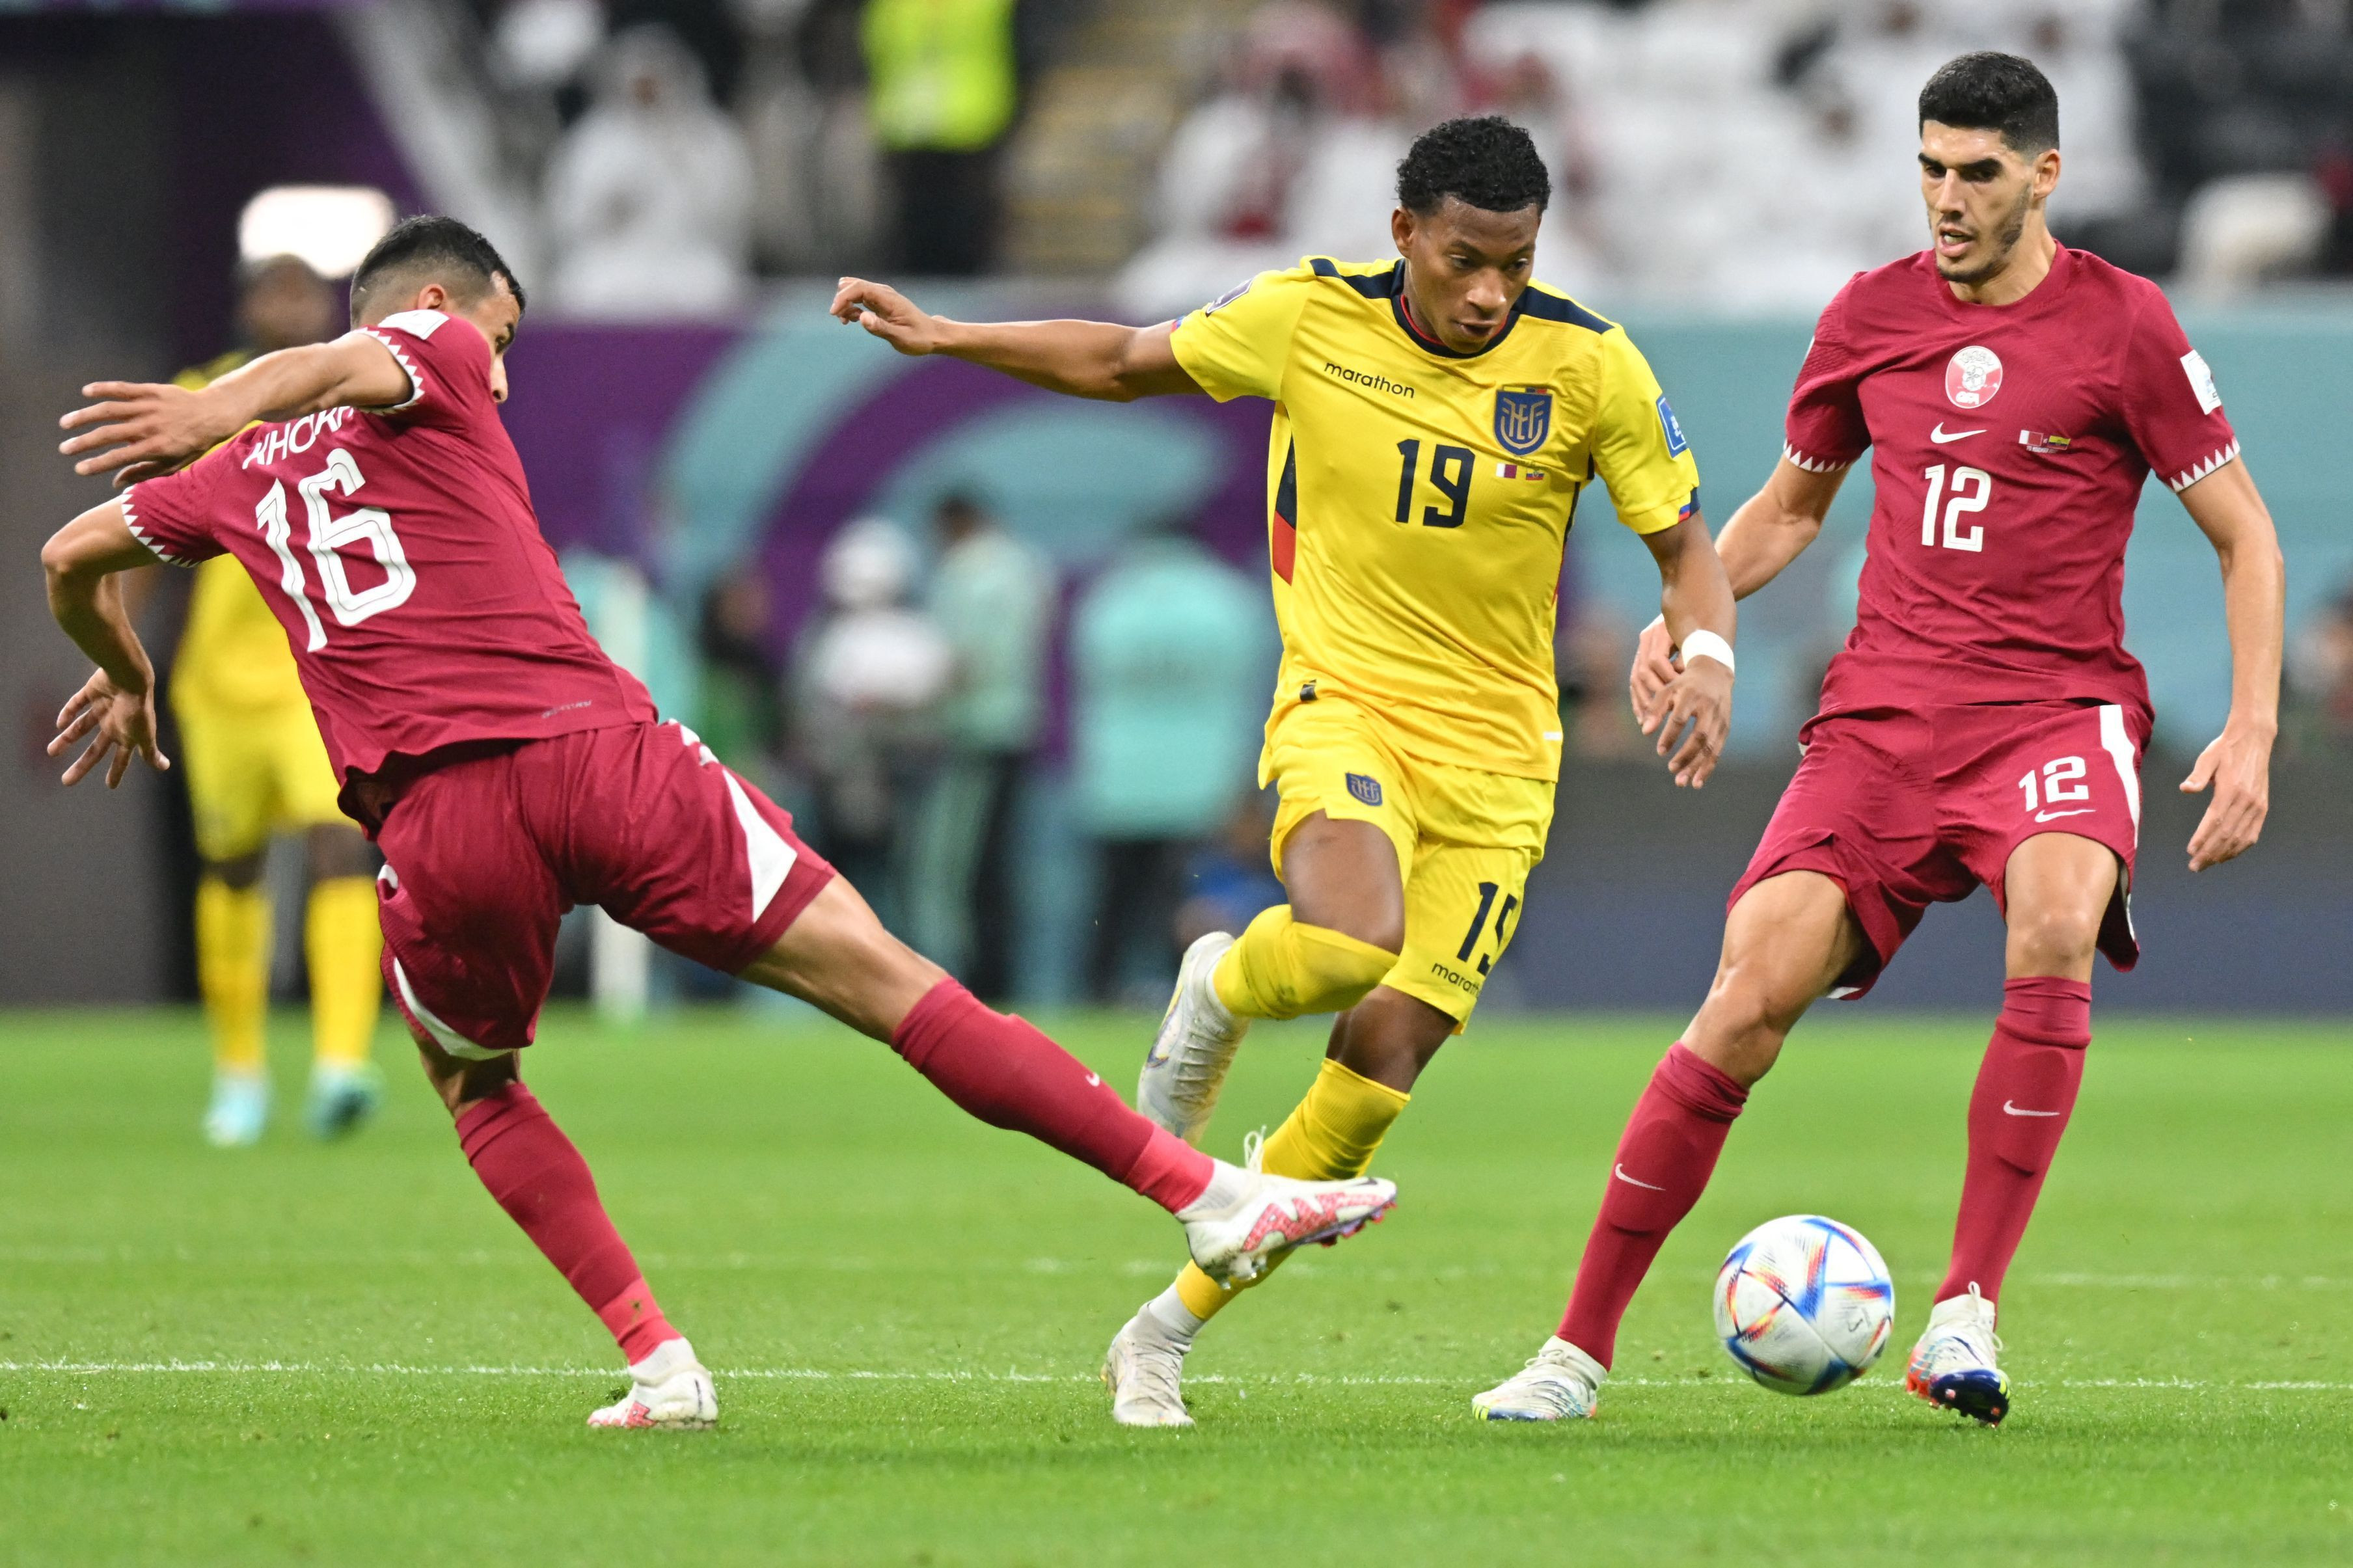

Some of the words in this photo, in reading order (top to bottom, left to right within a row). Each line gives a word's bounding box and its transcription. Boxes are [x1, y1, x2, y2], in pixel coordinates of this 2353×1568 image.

[1324, 362, 1415, 398] marathon
[1395, 439, 1476, 528] 19
[1922, 463, 1991, 552] 12
[255, 448, 416, 653] 16
[2019, 756, 2089, 812] 12
